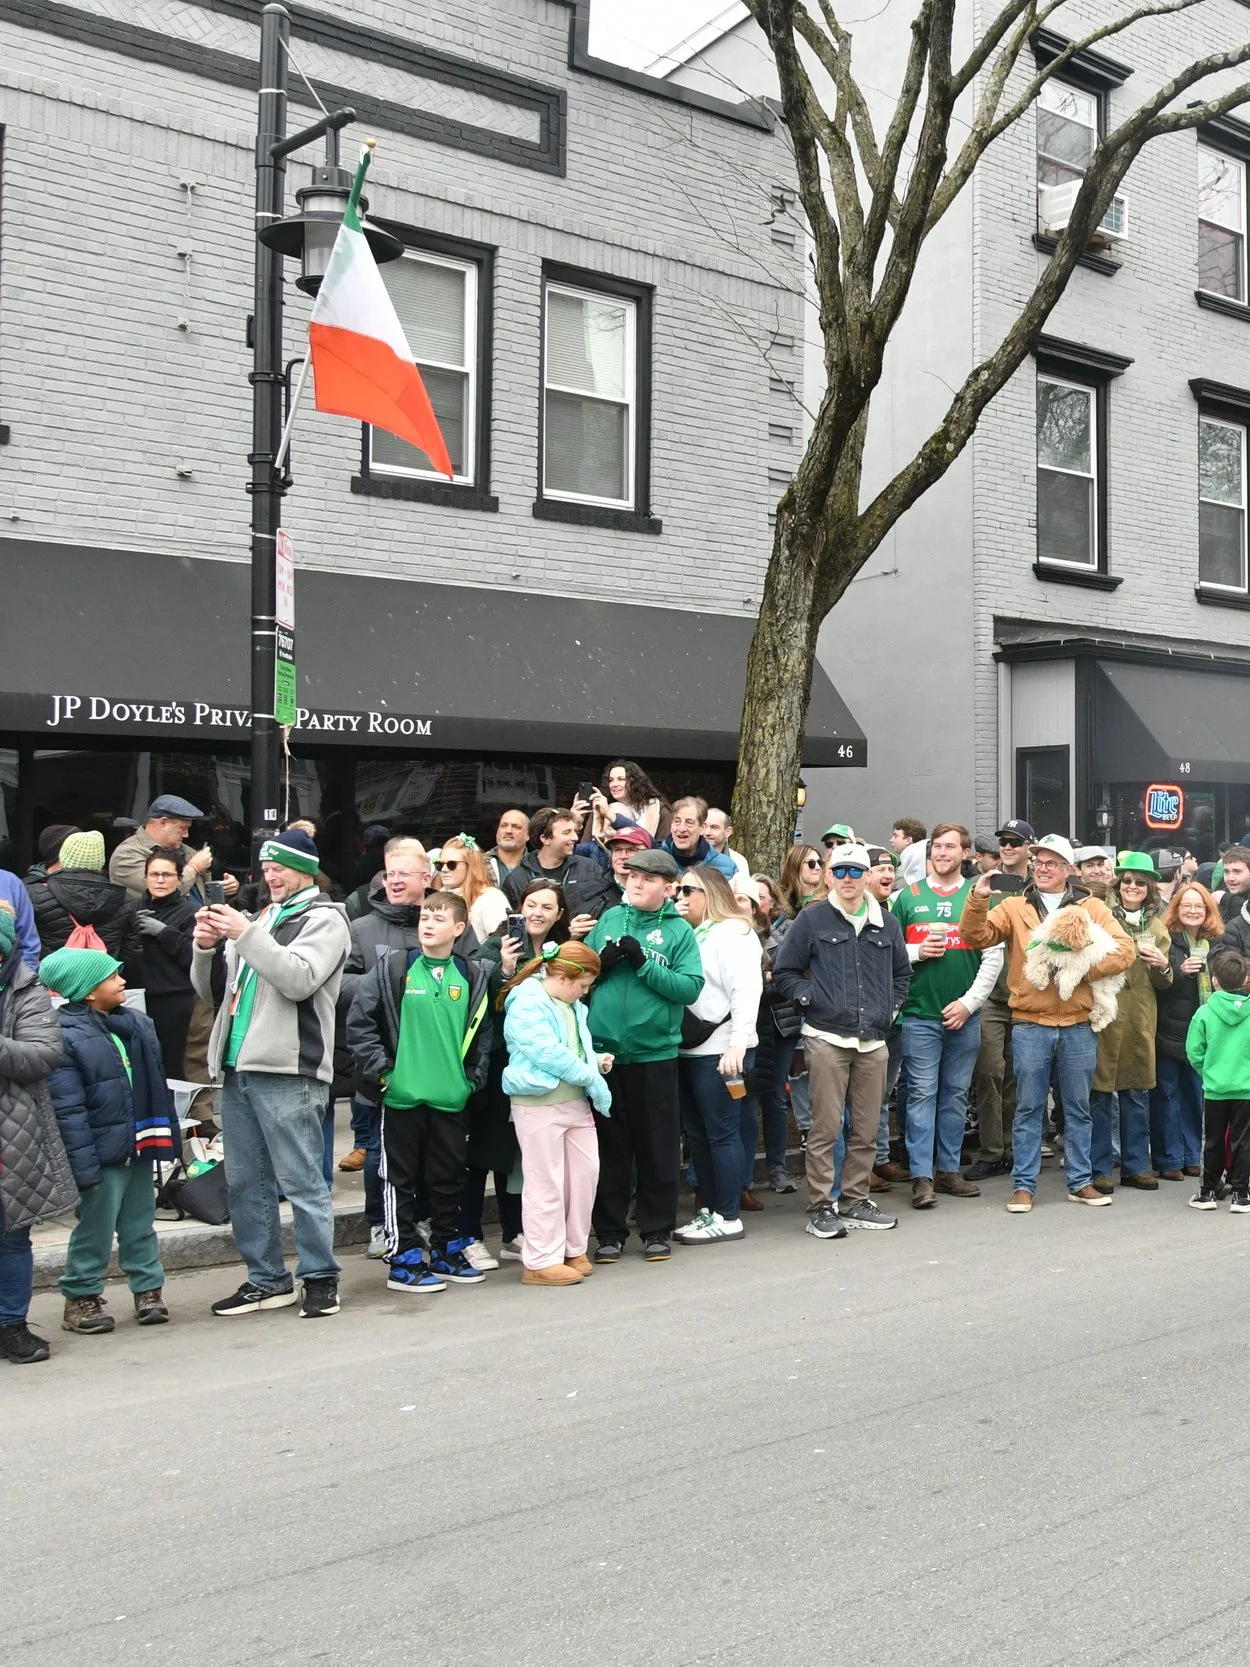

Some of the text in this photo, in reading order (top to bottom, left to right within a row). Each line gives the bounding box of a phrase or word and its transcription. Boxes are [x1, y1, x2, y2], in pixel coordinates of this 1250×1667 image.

[46, 695, 81, 727] JP
[88, 697, 186, 725] DOYLE'S
[295, 707, 362, 732] PARTY
[367, 711, 433, 736] ROOM
[837, 744, 854, 759] 46
[1179, 762, 1191, 774] 48
[1149, 791, 1179, 819] Lite
[936, 906, 952, 918] 75
